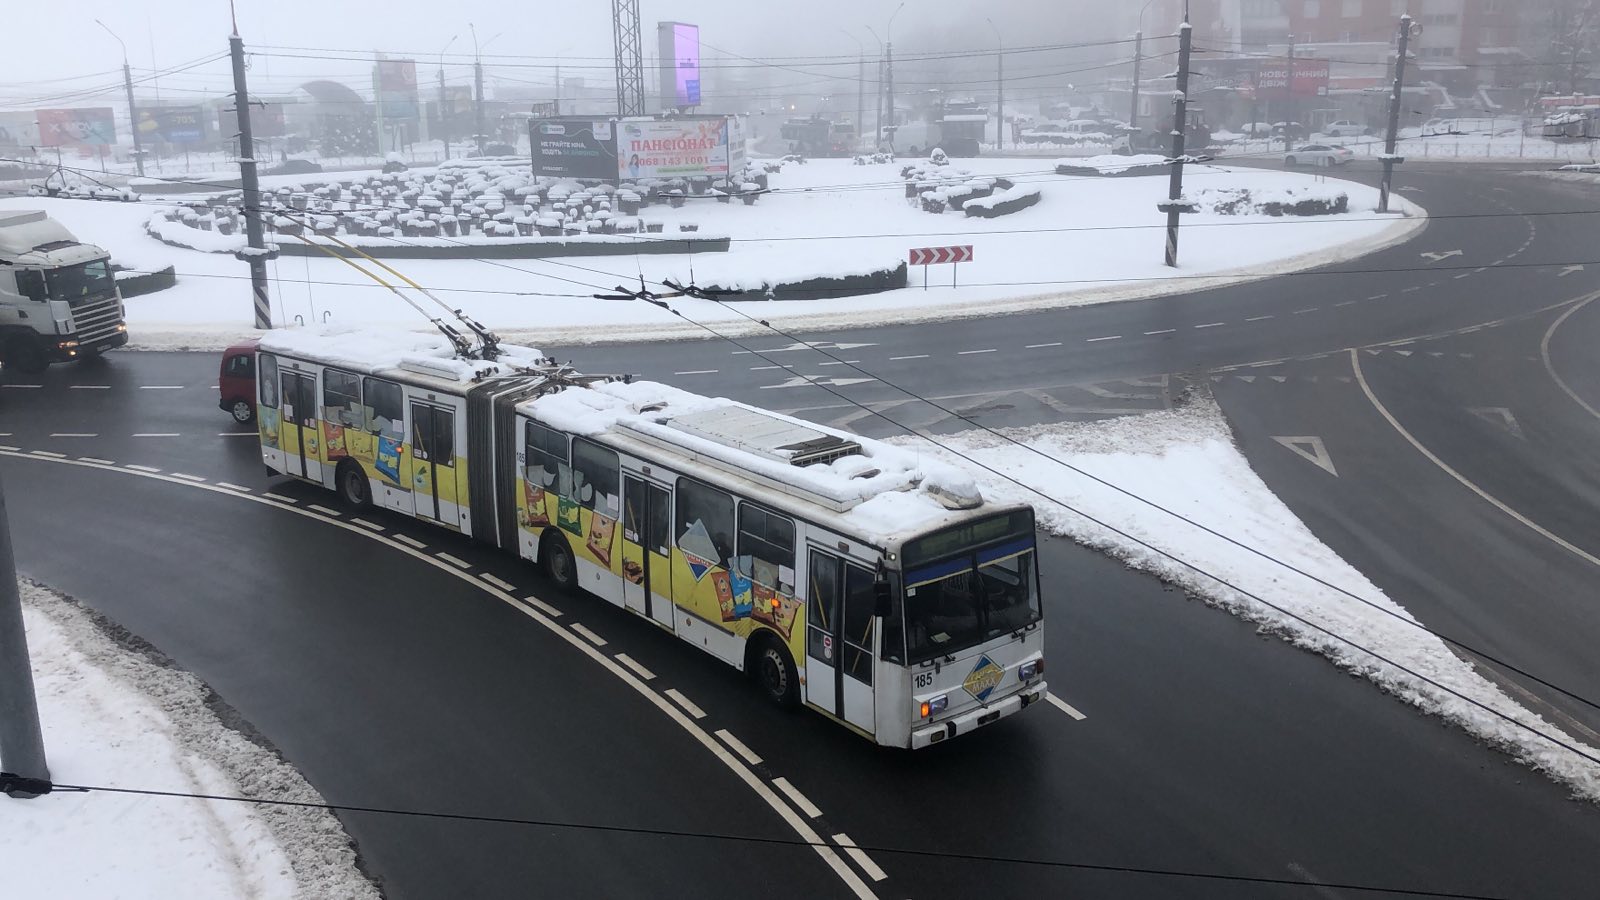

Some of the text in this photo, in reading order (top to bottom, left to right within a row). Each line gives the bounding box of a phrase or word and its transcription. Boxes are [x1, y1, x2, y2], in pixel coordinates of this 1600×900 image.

[1259, 69, 1328, 78] НОВОІЧНИЙ
[630, 138, 715, 151] ПАНСІОНАТ
[639, 157, 658, 166] 068
[663, 157, 681, 166] 143
[685, 156, 709, 165] 1001
[516, 452, 525, 463] 185
[915, 673, 933, 689] 185
